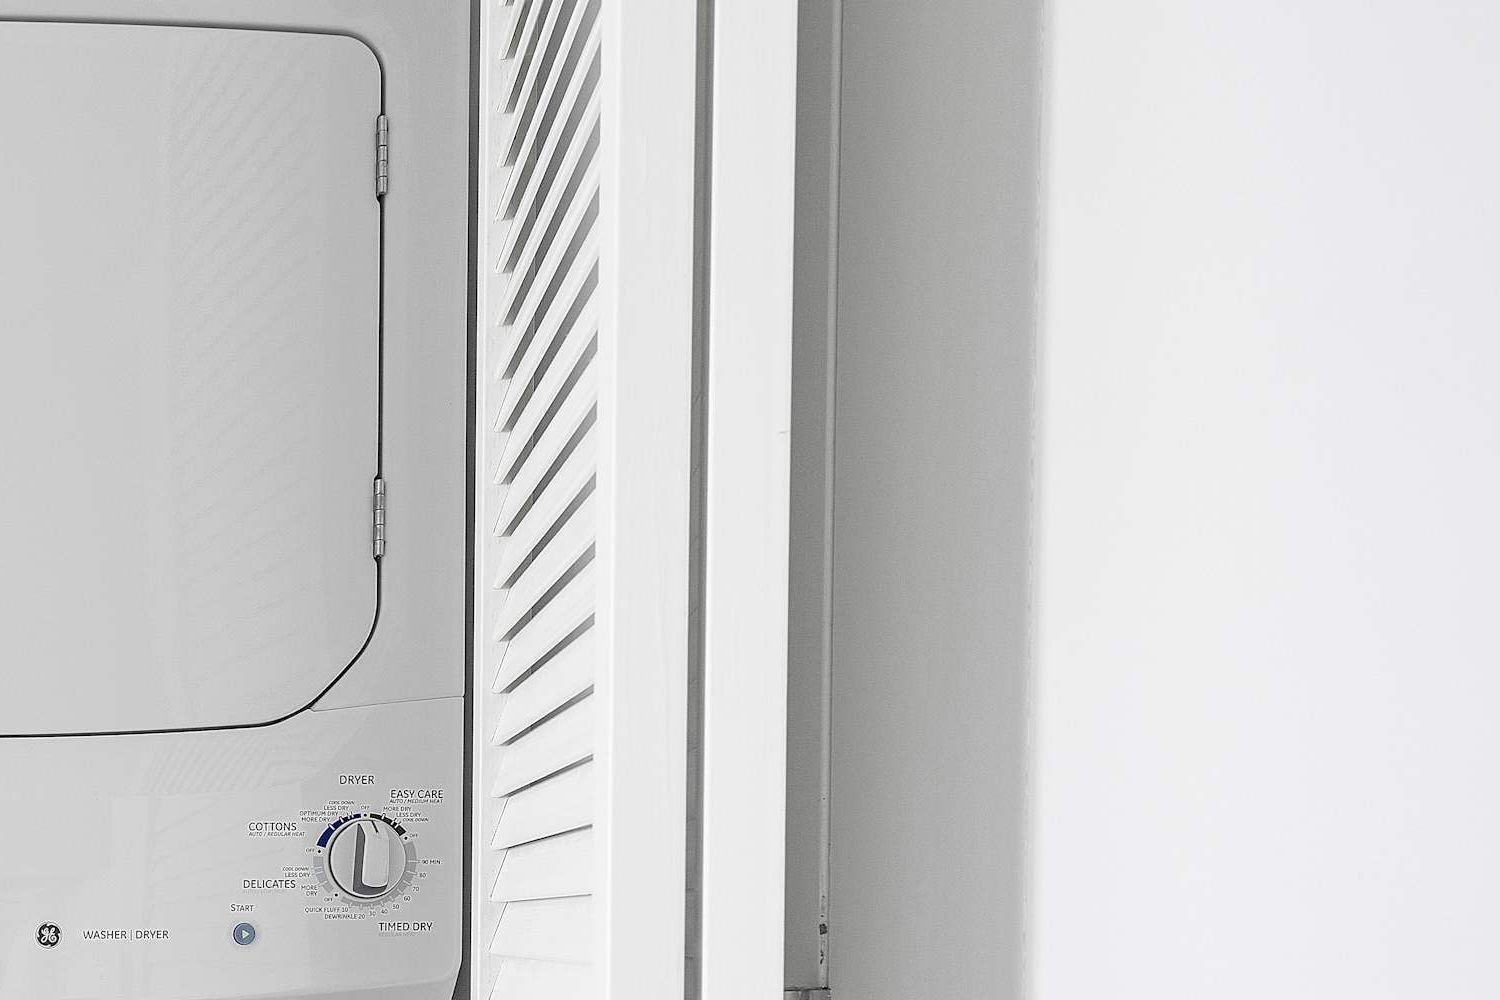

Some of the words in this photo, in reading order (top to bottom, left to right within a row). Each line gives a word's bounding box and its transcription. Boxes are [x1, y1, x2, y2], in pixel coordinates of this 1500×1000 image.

[339, 776, 375, 785] DRYER
[390, 790, 415, 799] EASY
[417, 790, 444, 799] CARE
[249, 822, 297, 831] COTTONS
[243, 880, 296, 888] DELICATES
[230, 904, 254, 912] START
[379, 922, 410, 931] TIMED
[412, 922, 433, 931] DRY
[83, 930, 127, 940] WASHER
[135, 930, 169, 939] DRYER
